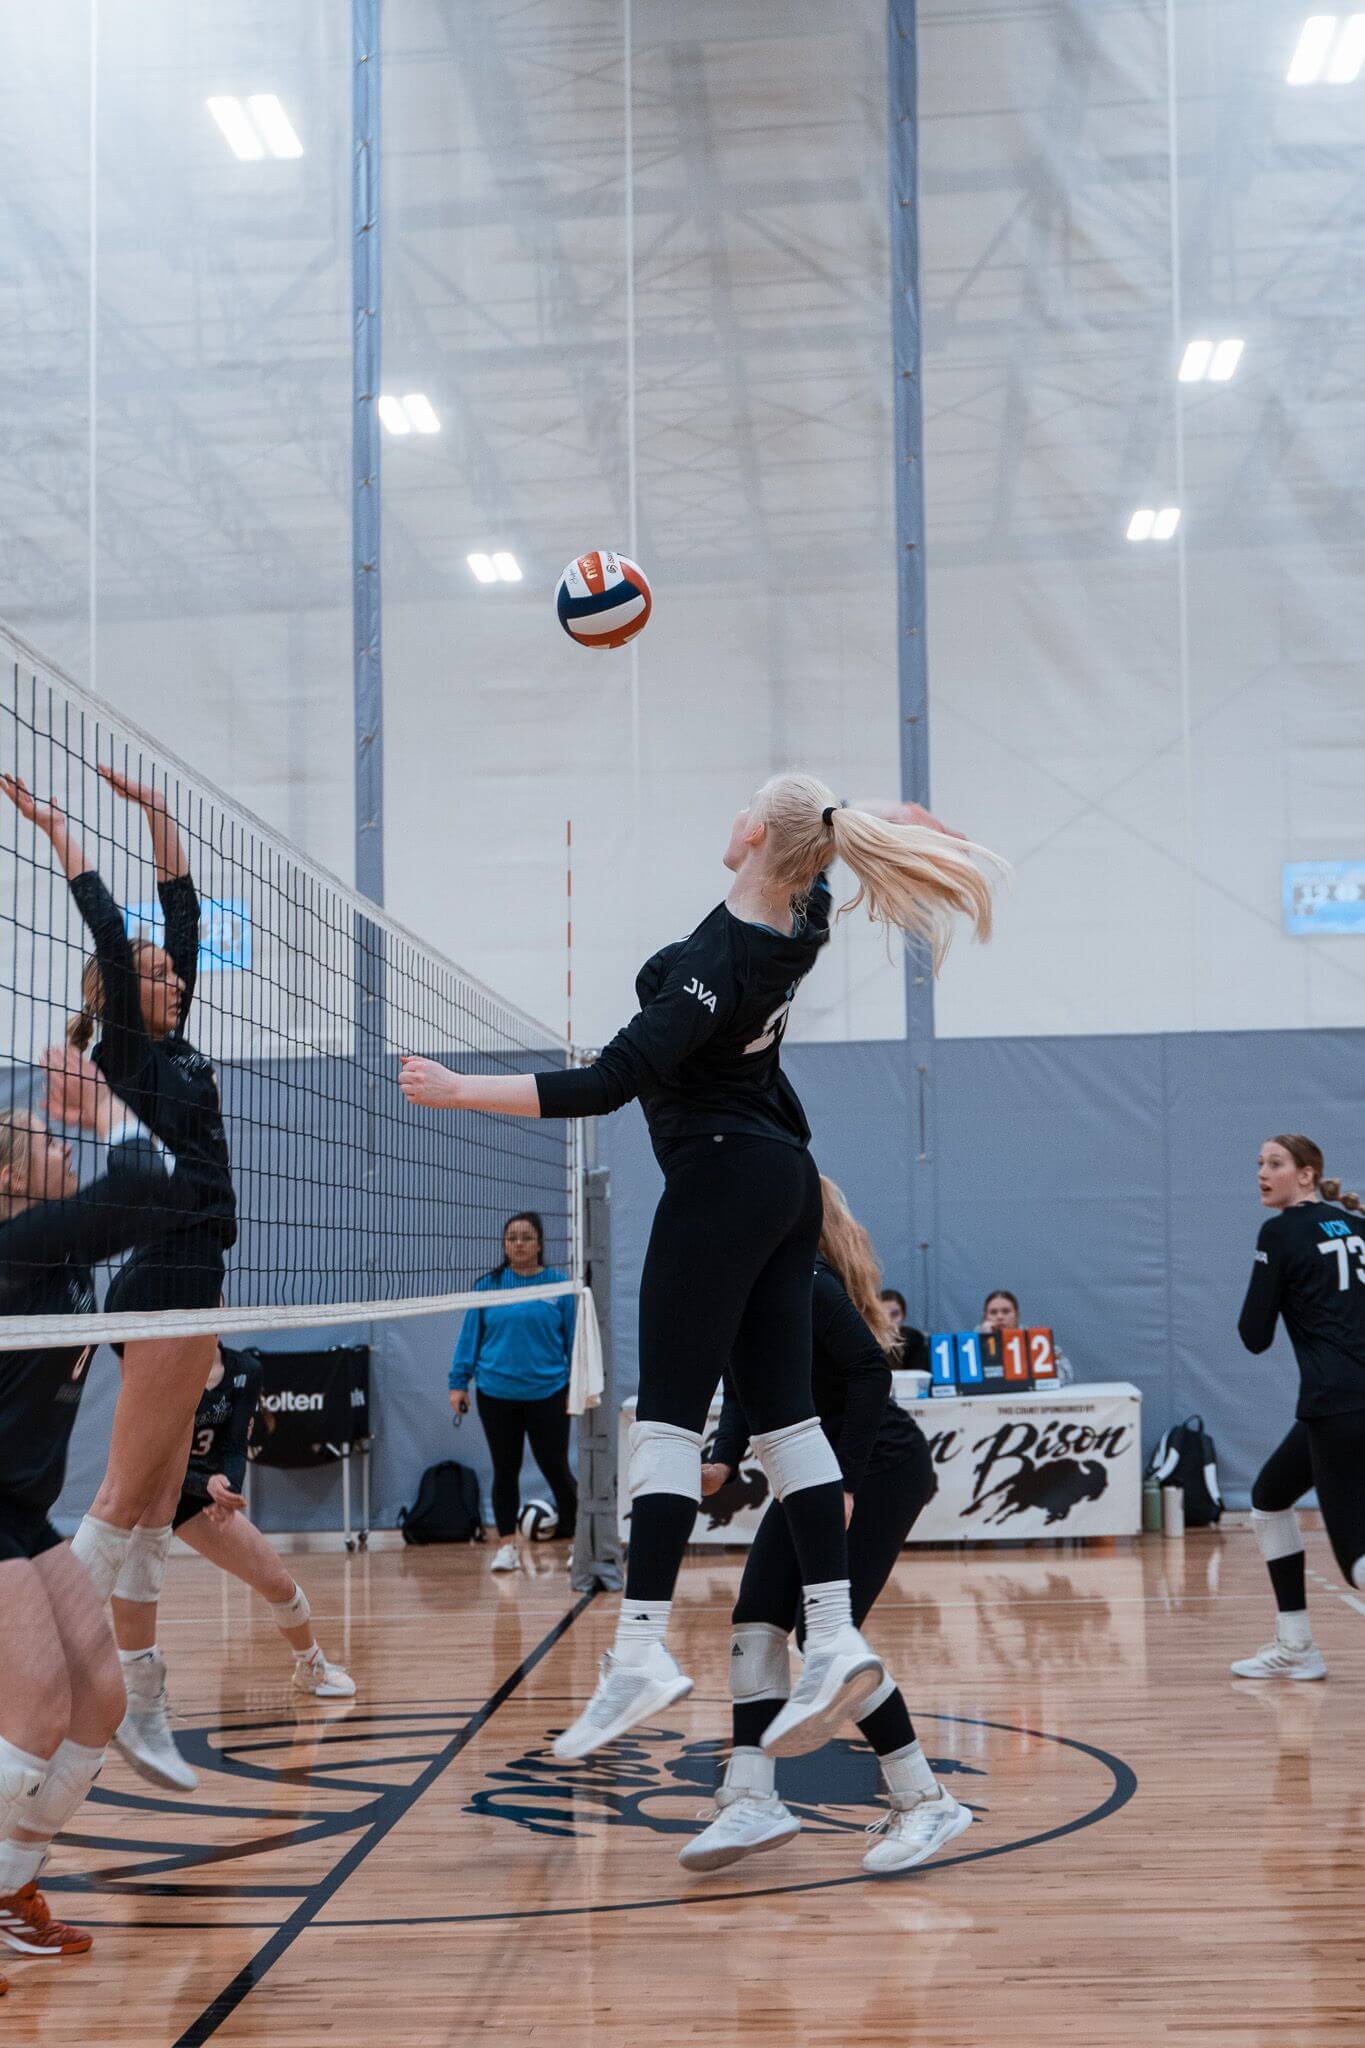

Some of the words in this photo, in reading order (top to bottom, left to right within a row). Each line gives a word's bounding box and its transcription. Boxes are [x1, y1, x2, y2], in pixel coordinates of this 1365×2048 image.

[683, 977, 718, 1014] JVA
[1317, 1236, 1365, 1291] 73
[959, 1420, 1133, 1517] Bison
